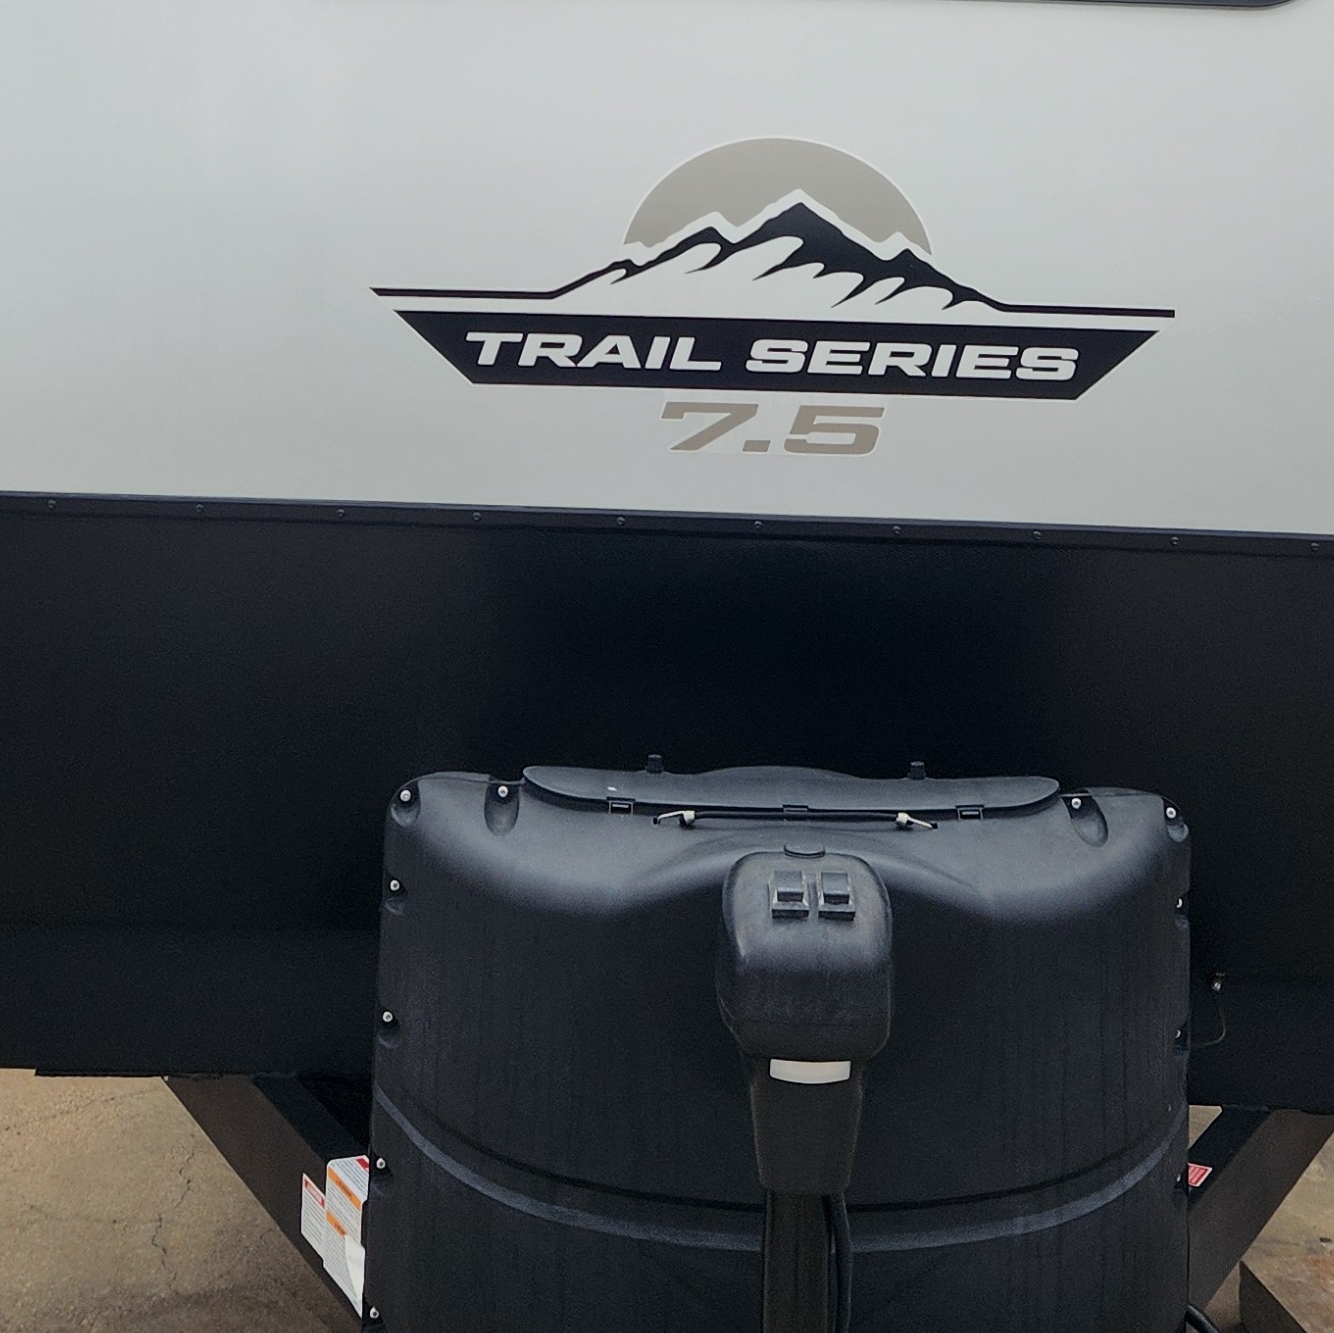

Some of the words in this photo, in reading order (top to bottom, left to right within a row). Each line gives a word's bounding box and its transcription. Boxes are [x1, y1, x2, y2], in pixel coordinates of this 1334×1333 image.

[465, 331, 722, 371] TRAIL
[745, 339, 1079, 381] SERIES
[660, 401, 885, 455] 7.5
